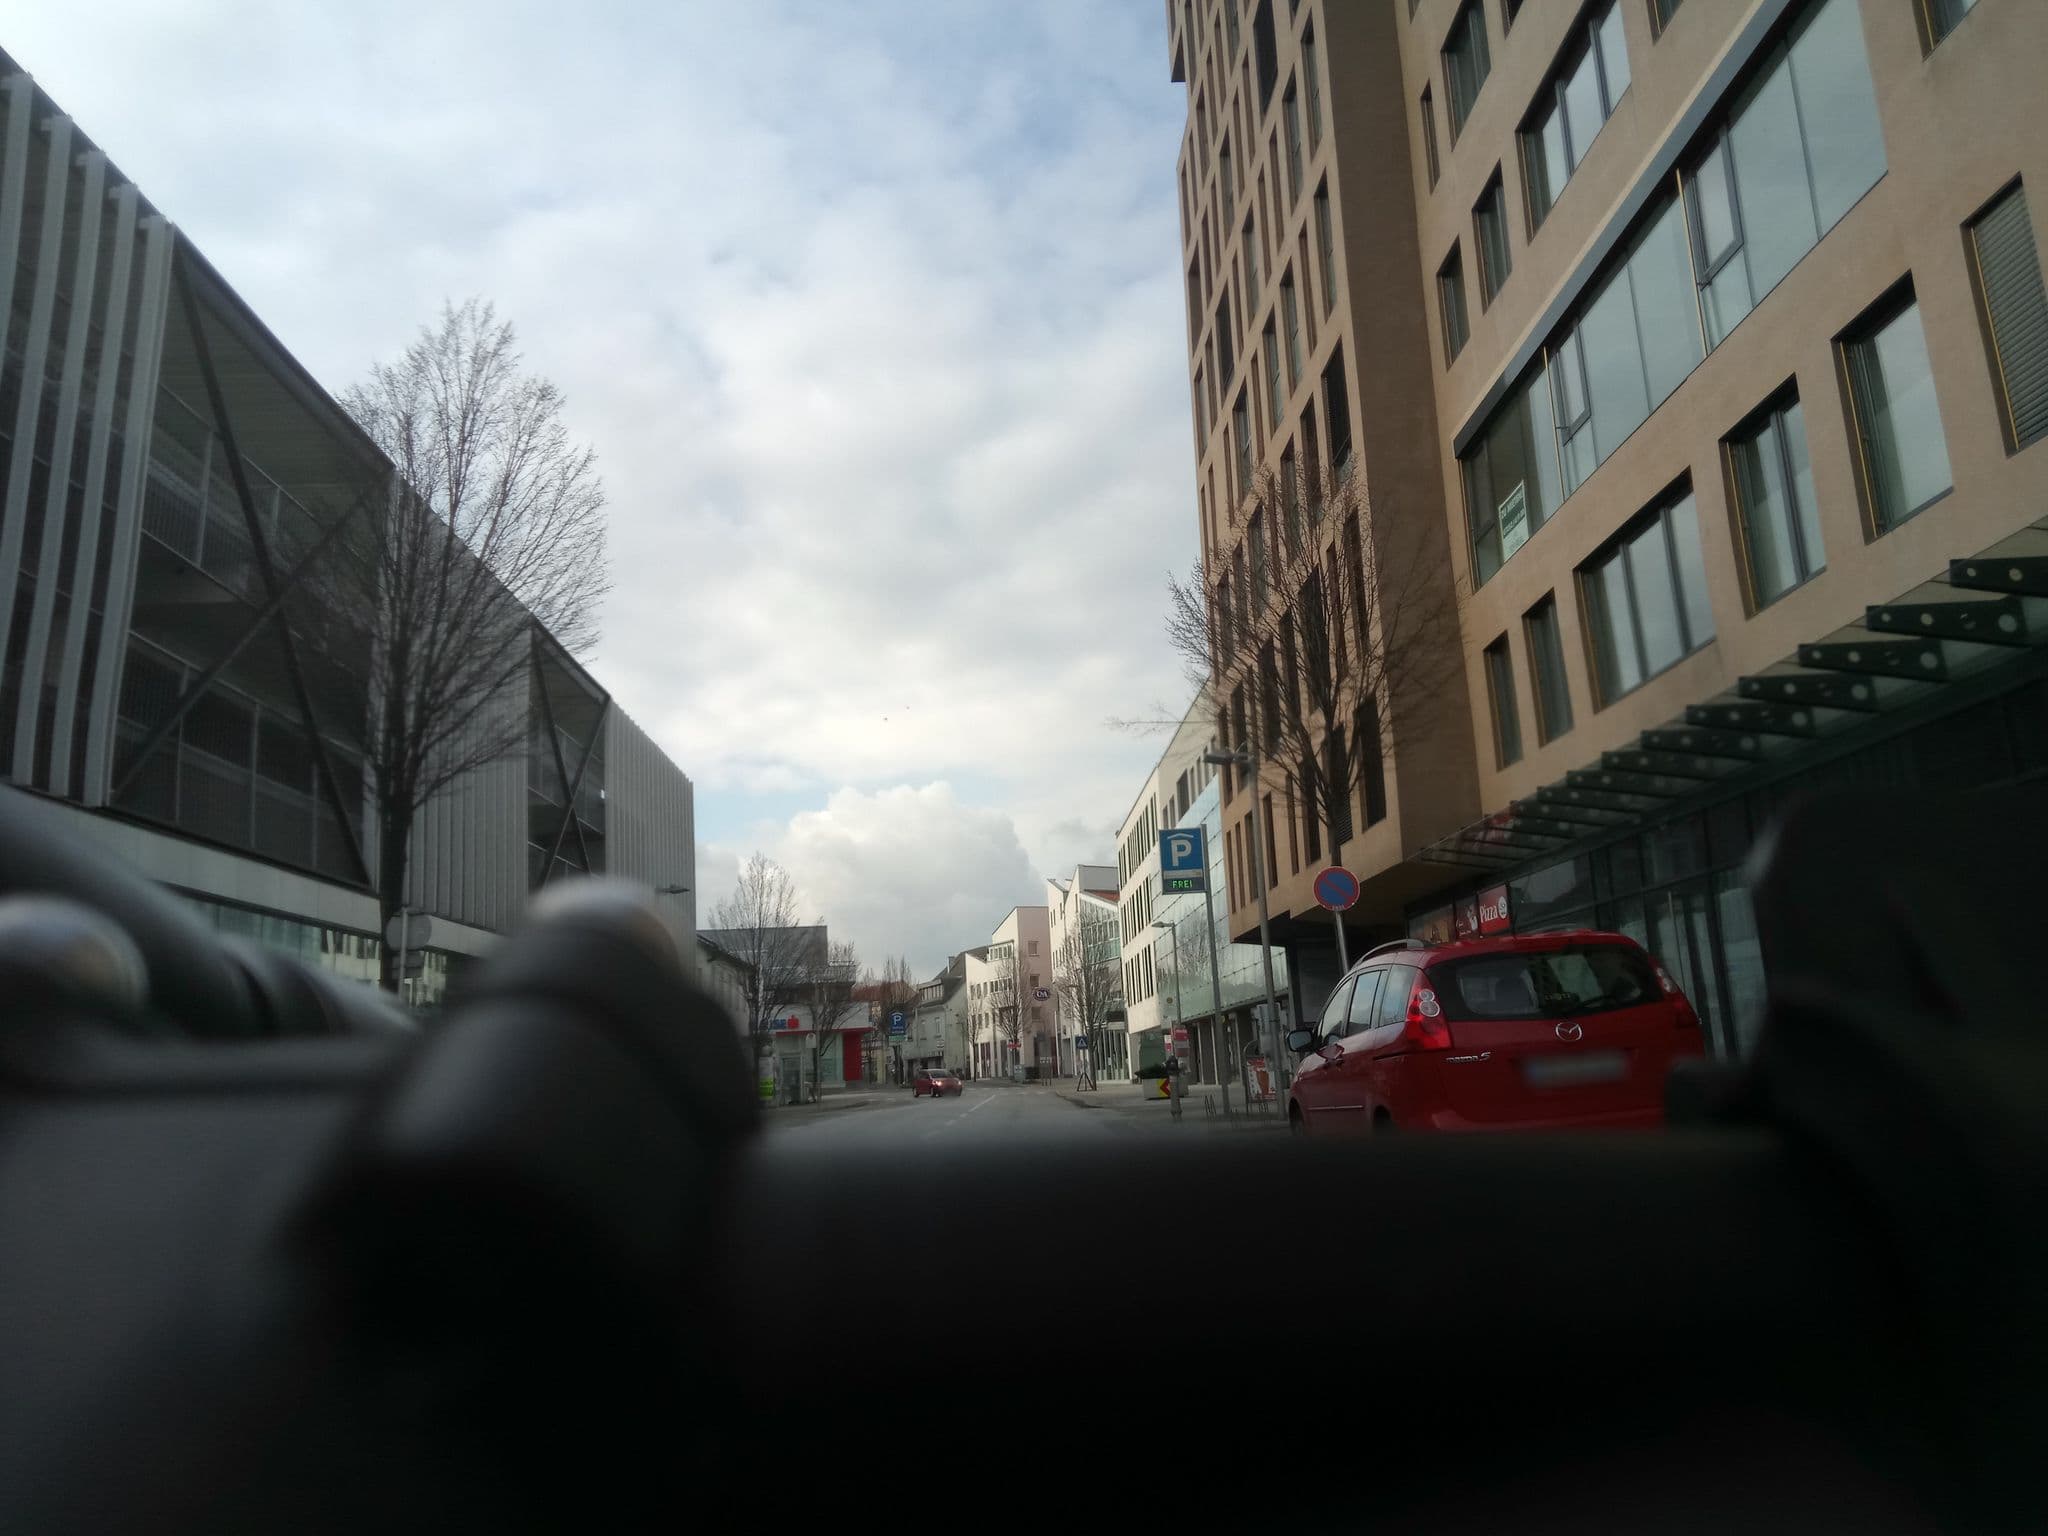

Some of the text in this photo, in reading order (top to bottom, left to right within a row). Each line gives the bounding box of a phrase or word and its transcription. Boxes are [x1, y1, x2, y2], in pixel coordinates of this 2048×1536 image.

[1171, 839, 1192, 867] P
[1172, 879, 1193, 889] FREI
[1479, 903, 1498, 924] Pizza
[893, 1015, 902, 1026] P
